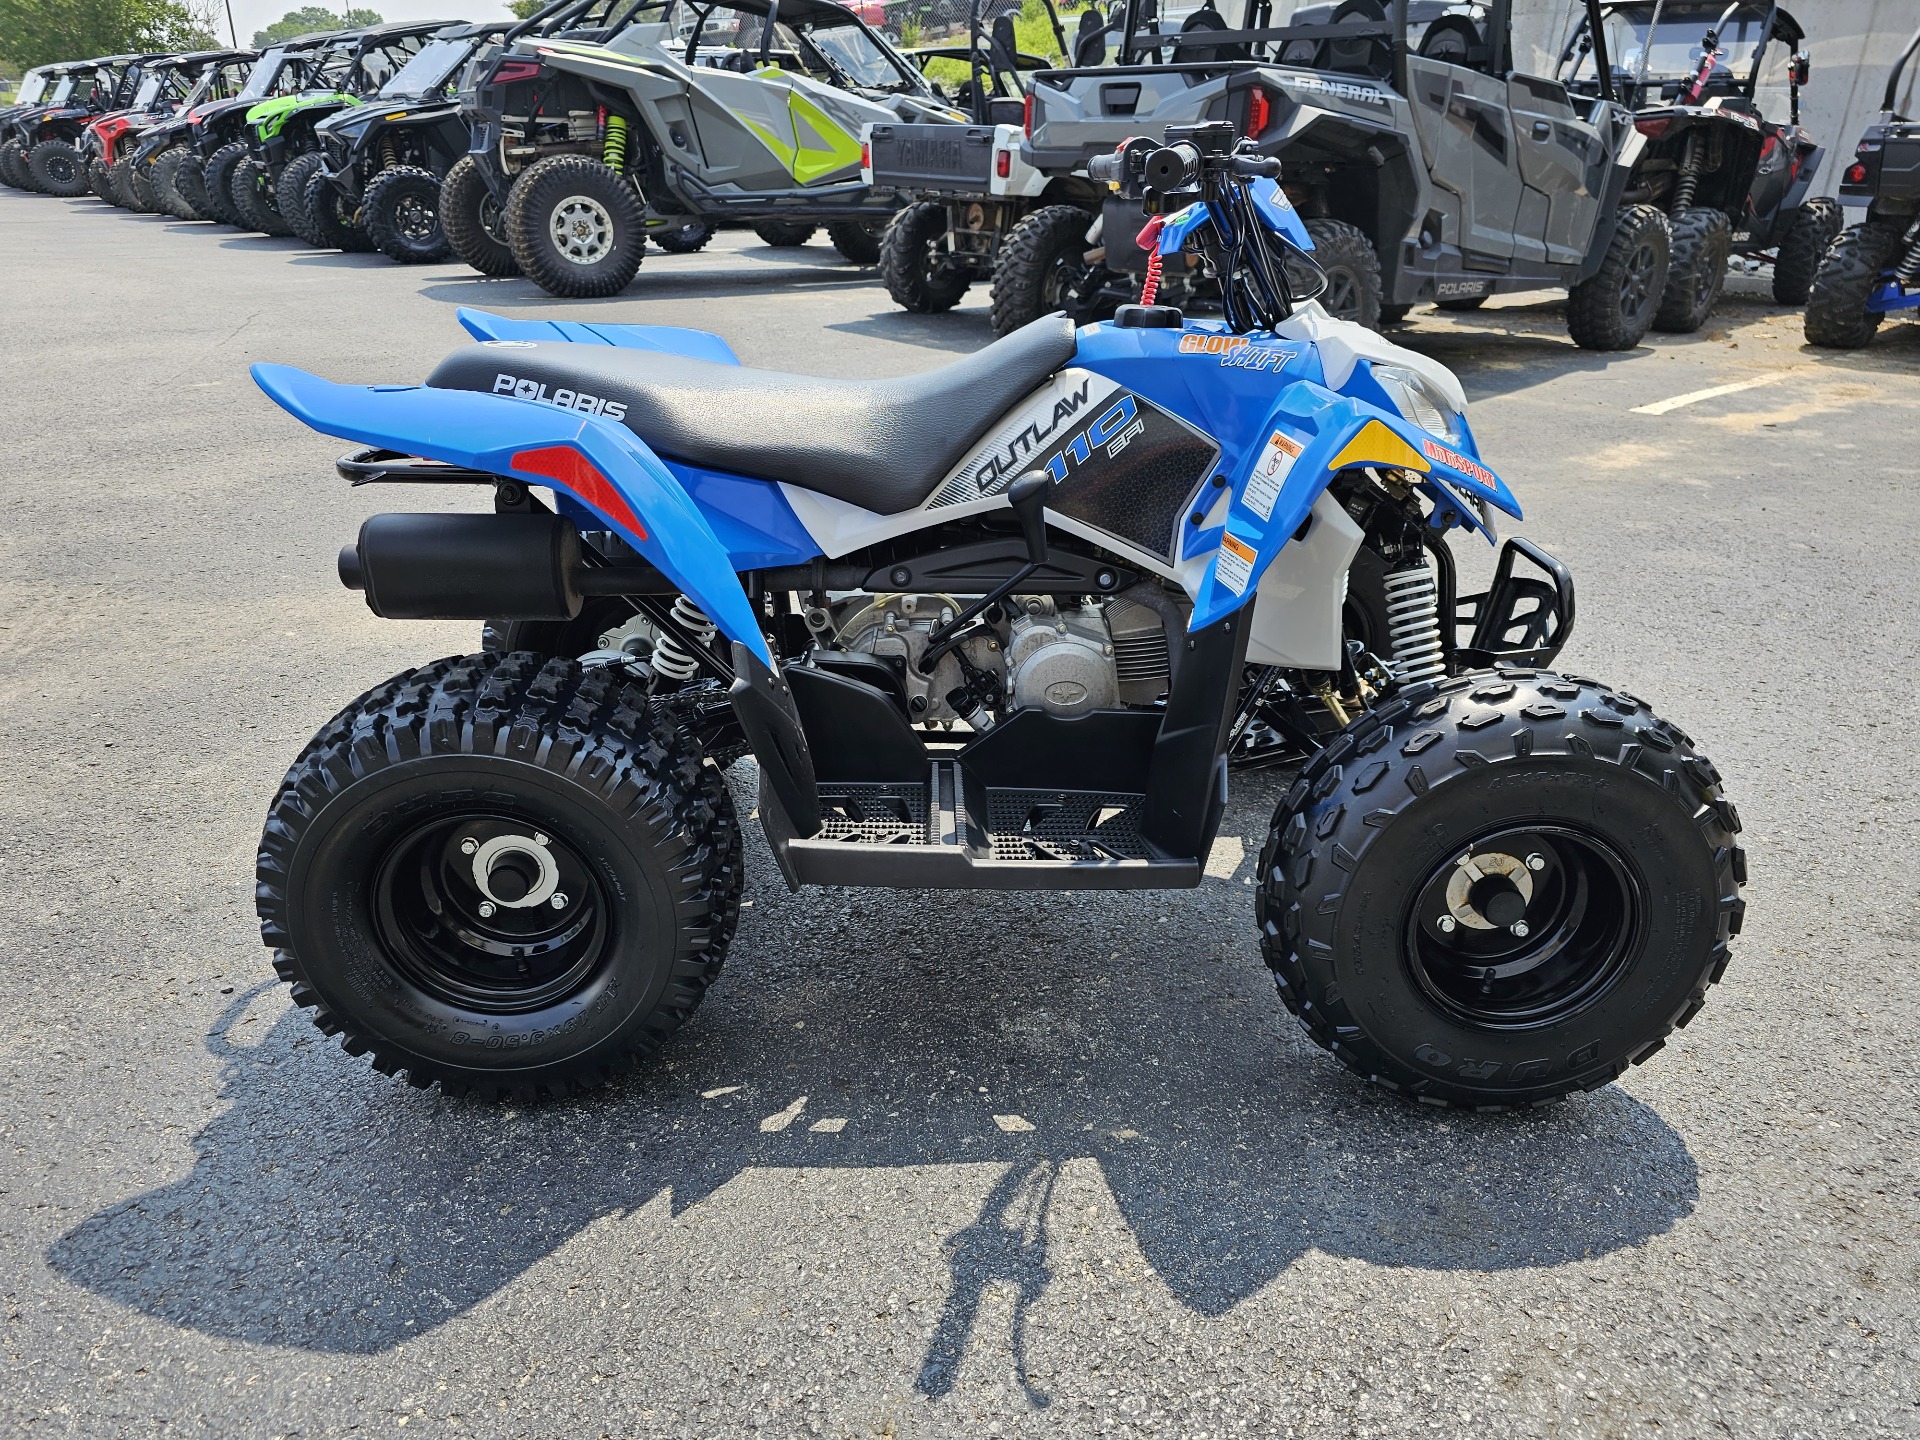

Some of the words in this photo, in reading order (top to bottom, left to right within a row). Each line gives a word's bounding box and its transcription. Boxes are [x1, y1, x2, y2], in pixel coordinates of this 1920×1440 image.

[1294, 76, 1384, 105] GENERAL
[896, 137, 963, 169] YAMAHA
[1437, 280, 1485, 296] POLARIS
[1179, 334, 1251, 355] GLOW
[1220, 345, 1298, 373] SHIFT
[492, 373, 629, 422] POLARIS
[975, 376, 1090, 493] OUTLAW
[1043, 394, 1139, 485] 110
[1106, 418, 1145, 460] EFI
[1413, 1038, 1602, 1081] DURO
